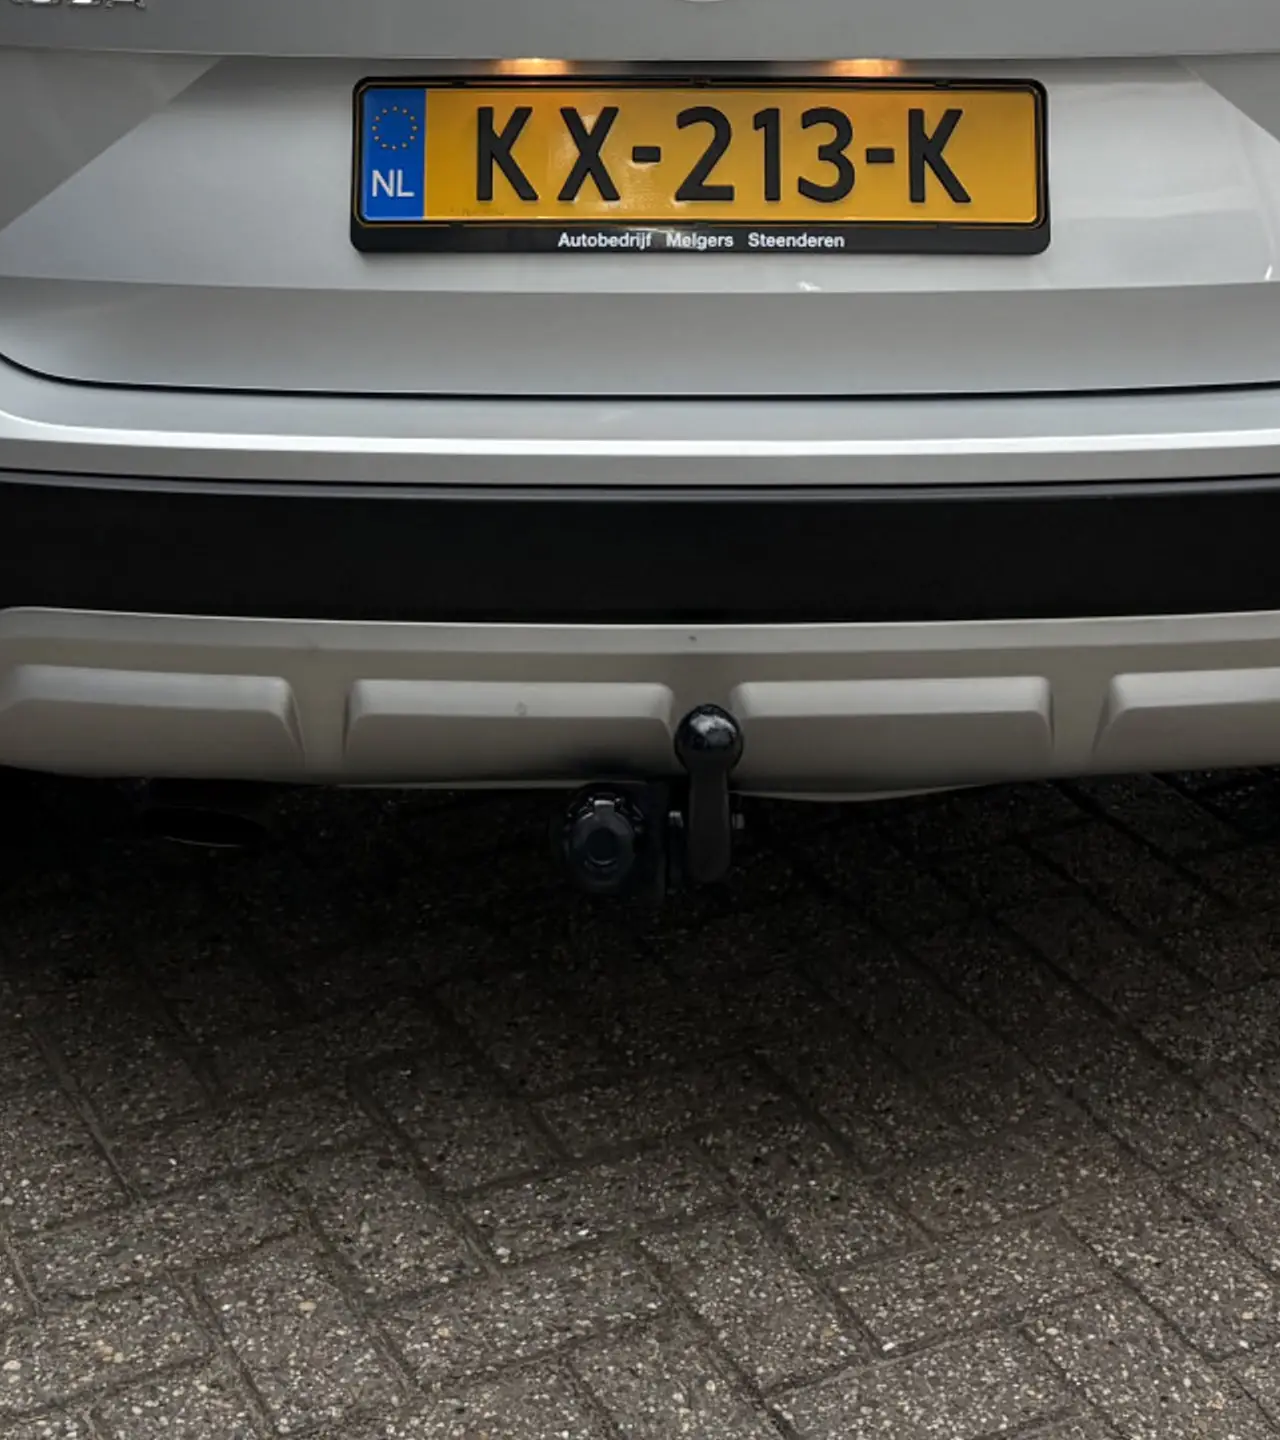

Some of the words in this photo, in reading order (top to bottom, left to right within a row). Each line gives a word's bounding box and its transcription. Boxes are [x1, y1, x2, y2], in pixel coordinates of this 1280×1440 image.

[475, 106, 973, 203] KX-213-K
[371, 169, 415, 198] NL
[558, 231, 652, 250] Autobedrijf
[666, 231, 734, 250] Melgers
[747, 231, 845, 248] Steenderen
